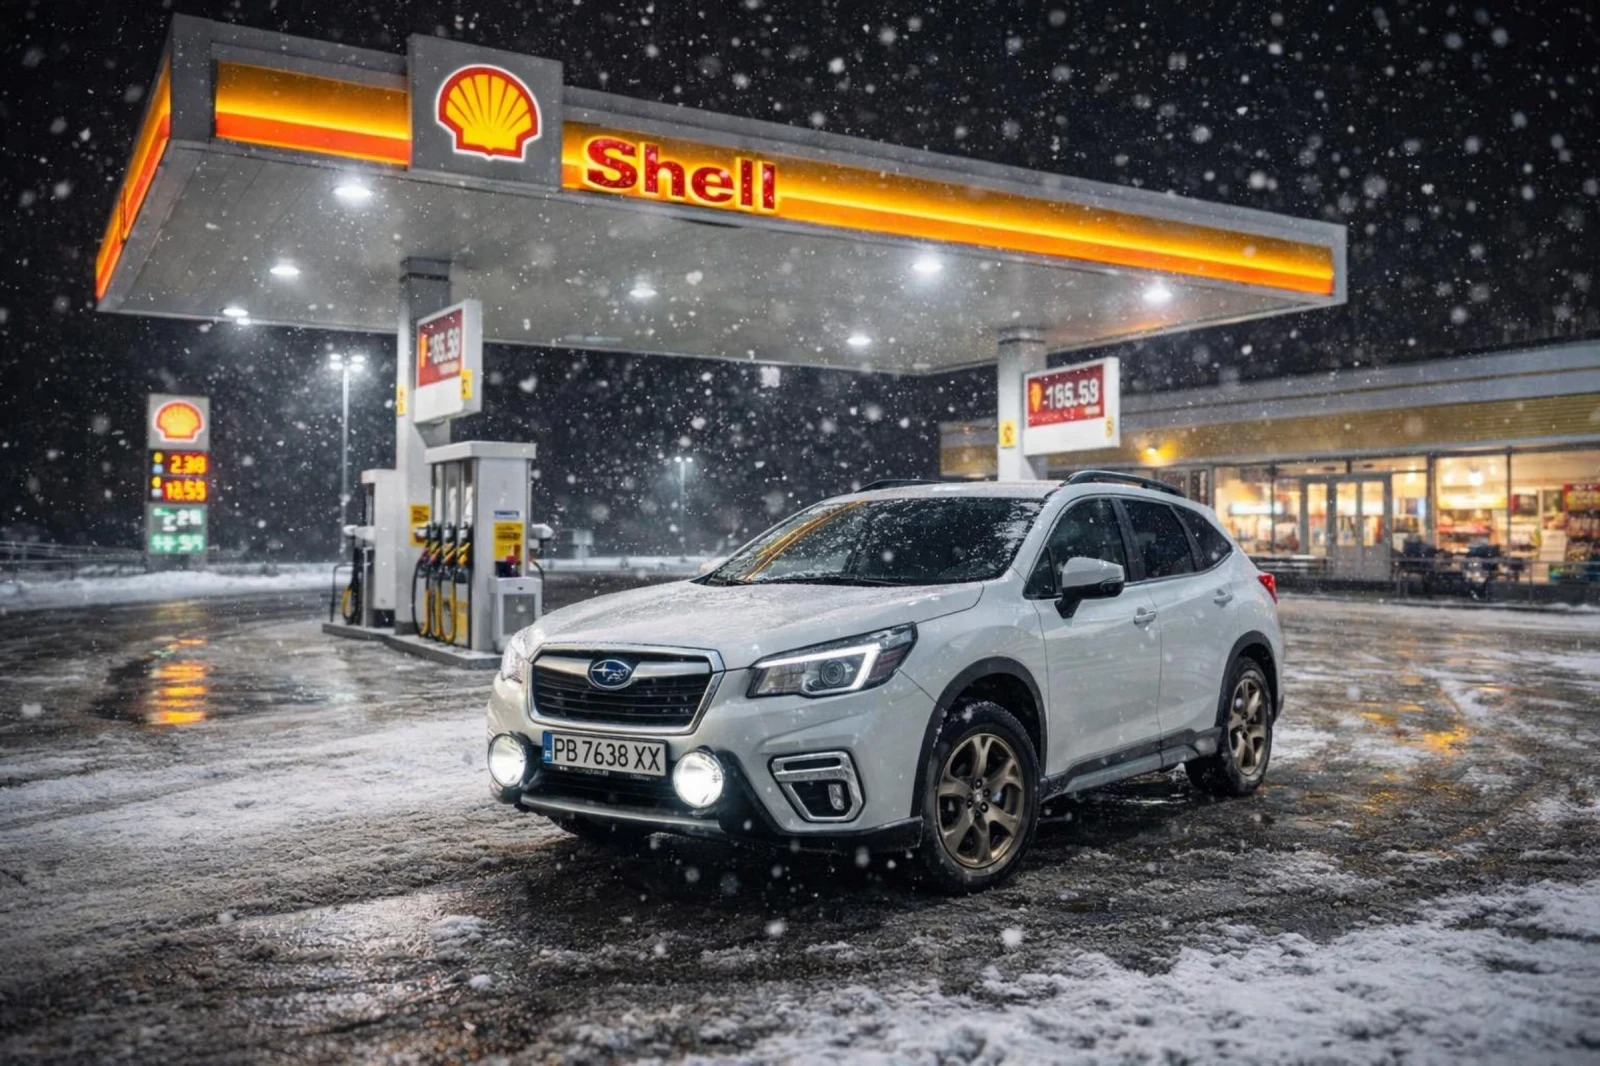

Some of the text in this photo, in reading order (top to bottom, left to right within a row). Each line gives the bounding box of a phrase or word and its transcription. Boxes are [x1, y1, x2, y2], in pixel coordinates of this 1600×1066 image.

[586, 137, 777, 211] Shell
[553, 738, 661, 772] PB 7638 XX
